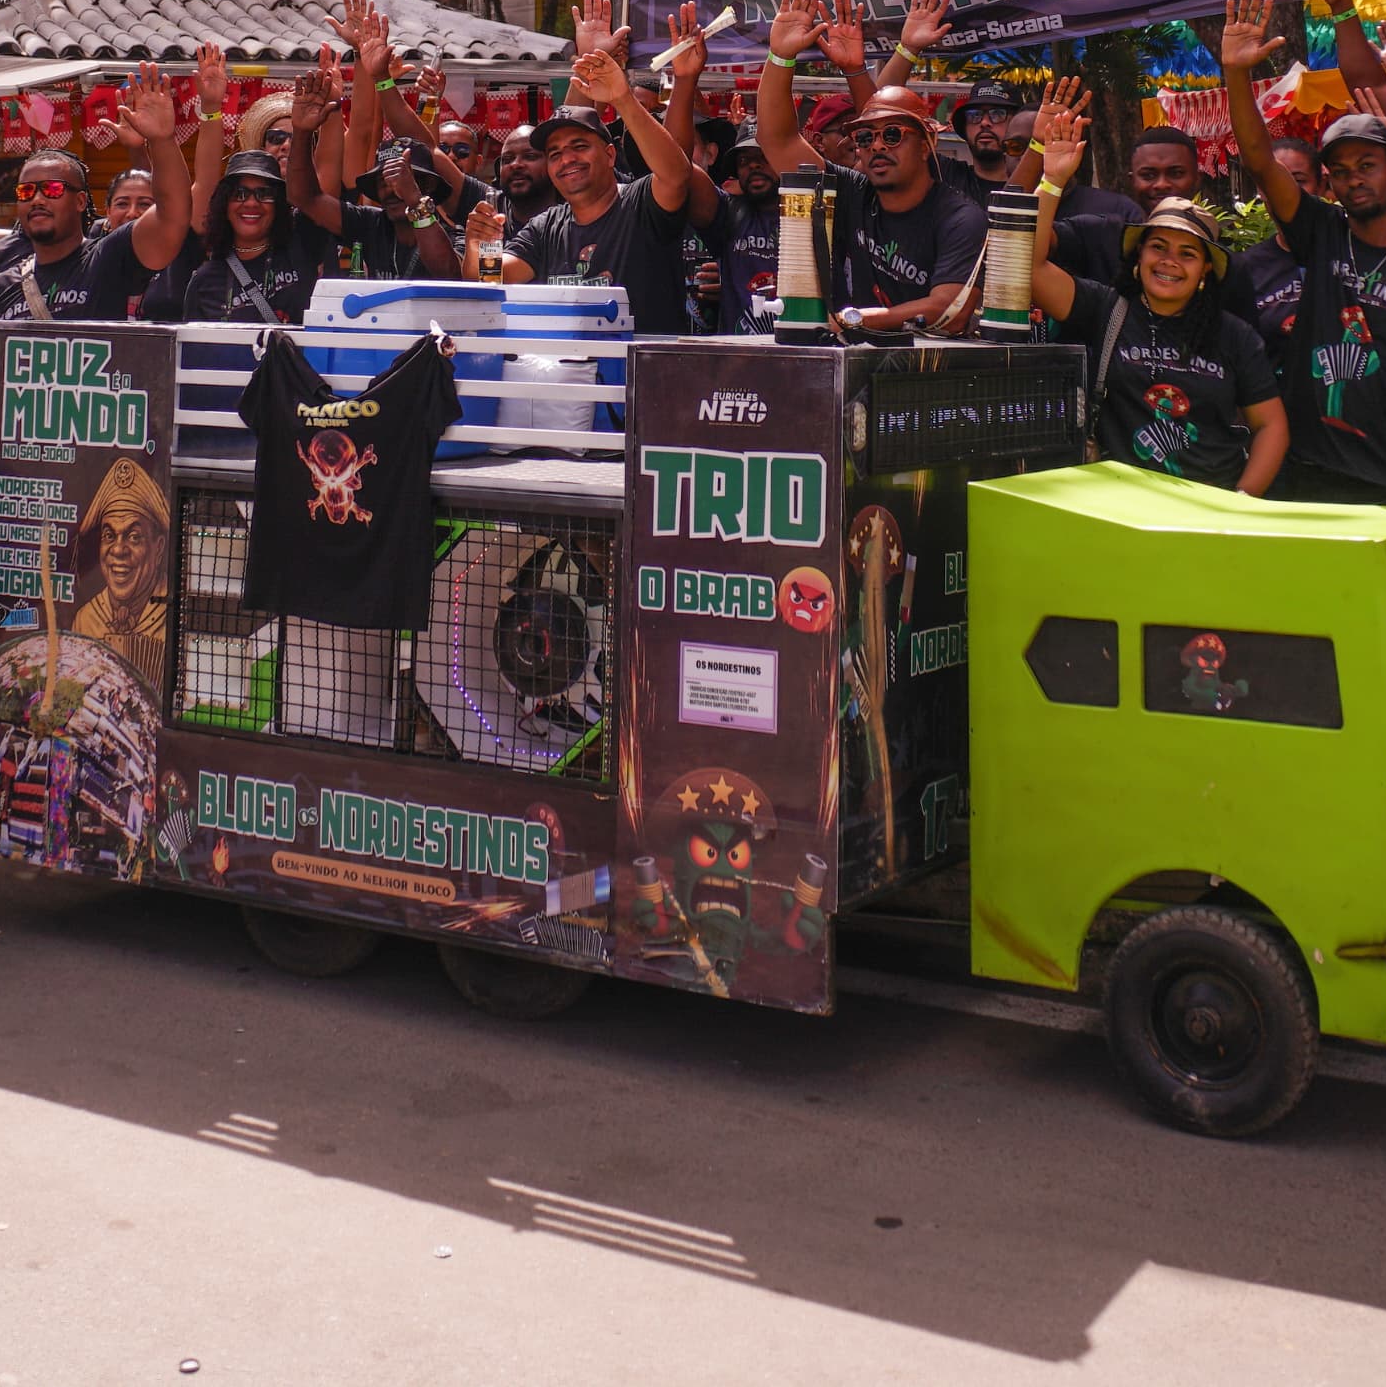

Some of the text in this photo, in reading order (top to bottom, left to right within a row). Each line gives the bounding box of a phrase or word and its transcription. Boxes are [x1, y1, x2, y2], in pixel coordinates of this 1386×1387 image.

[5, 336, 111, 388] CRUZ
[712, 392, 759, 402] EURICLES
[2, 442, 76, 463] NO SÃO JOÃO!
[18, 498, 28, 519] É
[28, 499, 45, 521] SÓ
[45, 503, 77, 523] ONDE
[641, 445, 827, 548] TRIO
[15, 549, 33, 567] ME
[639, 565, 665, 611] O
[696, 660, 762, 676] OS NORDESTINOS
[197, 770, 549, 886] BLOCO OS NORDESTINOS
[276, 857, 451, 898] BEM-VINDO AO MELHOR BLOCO
